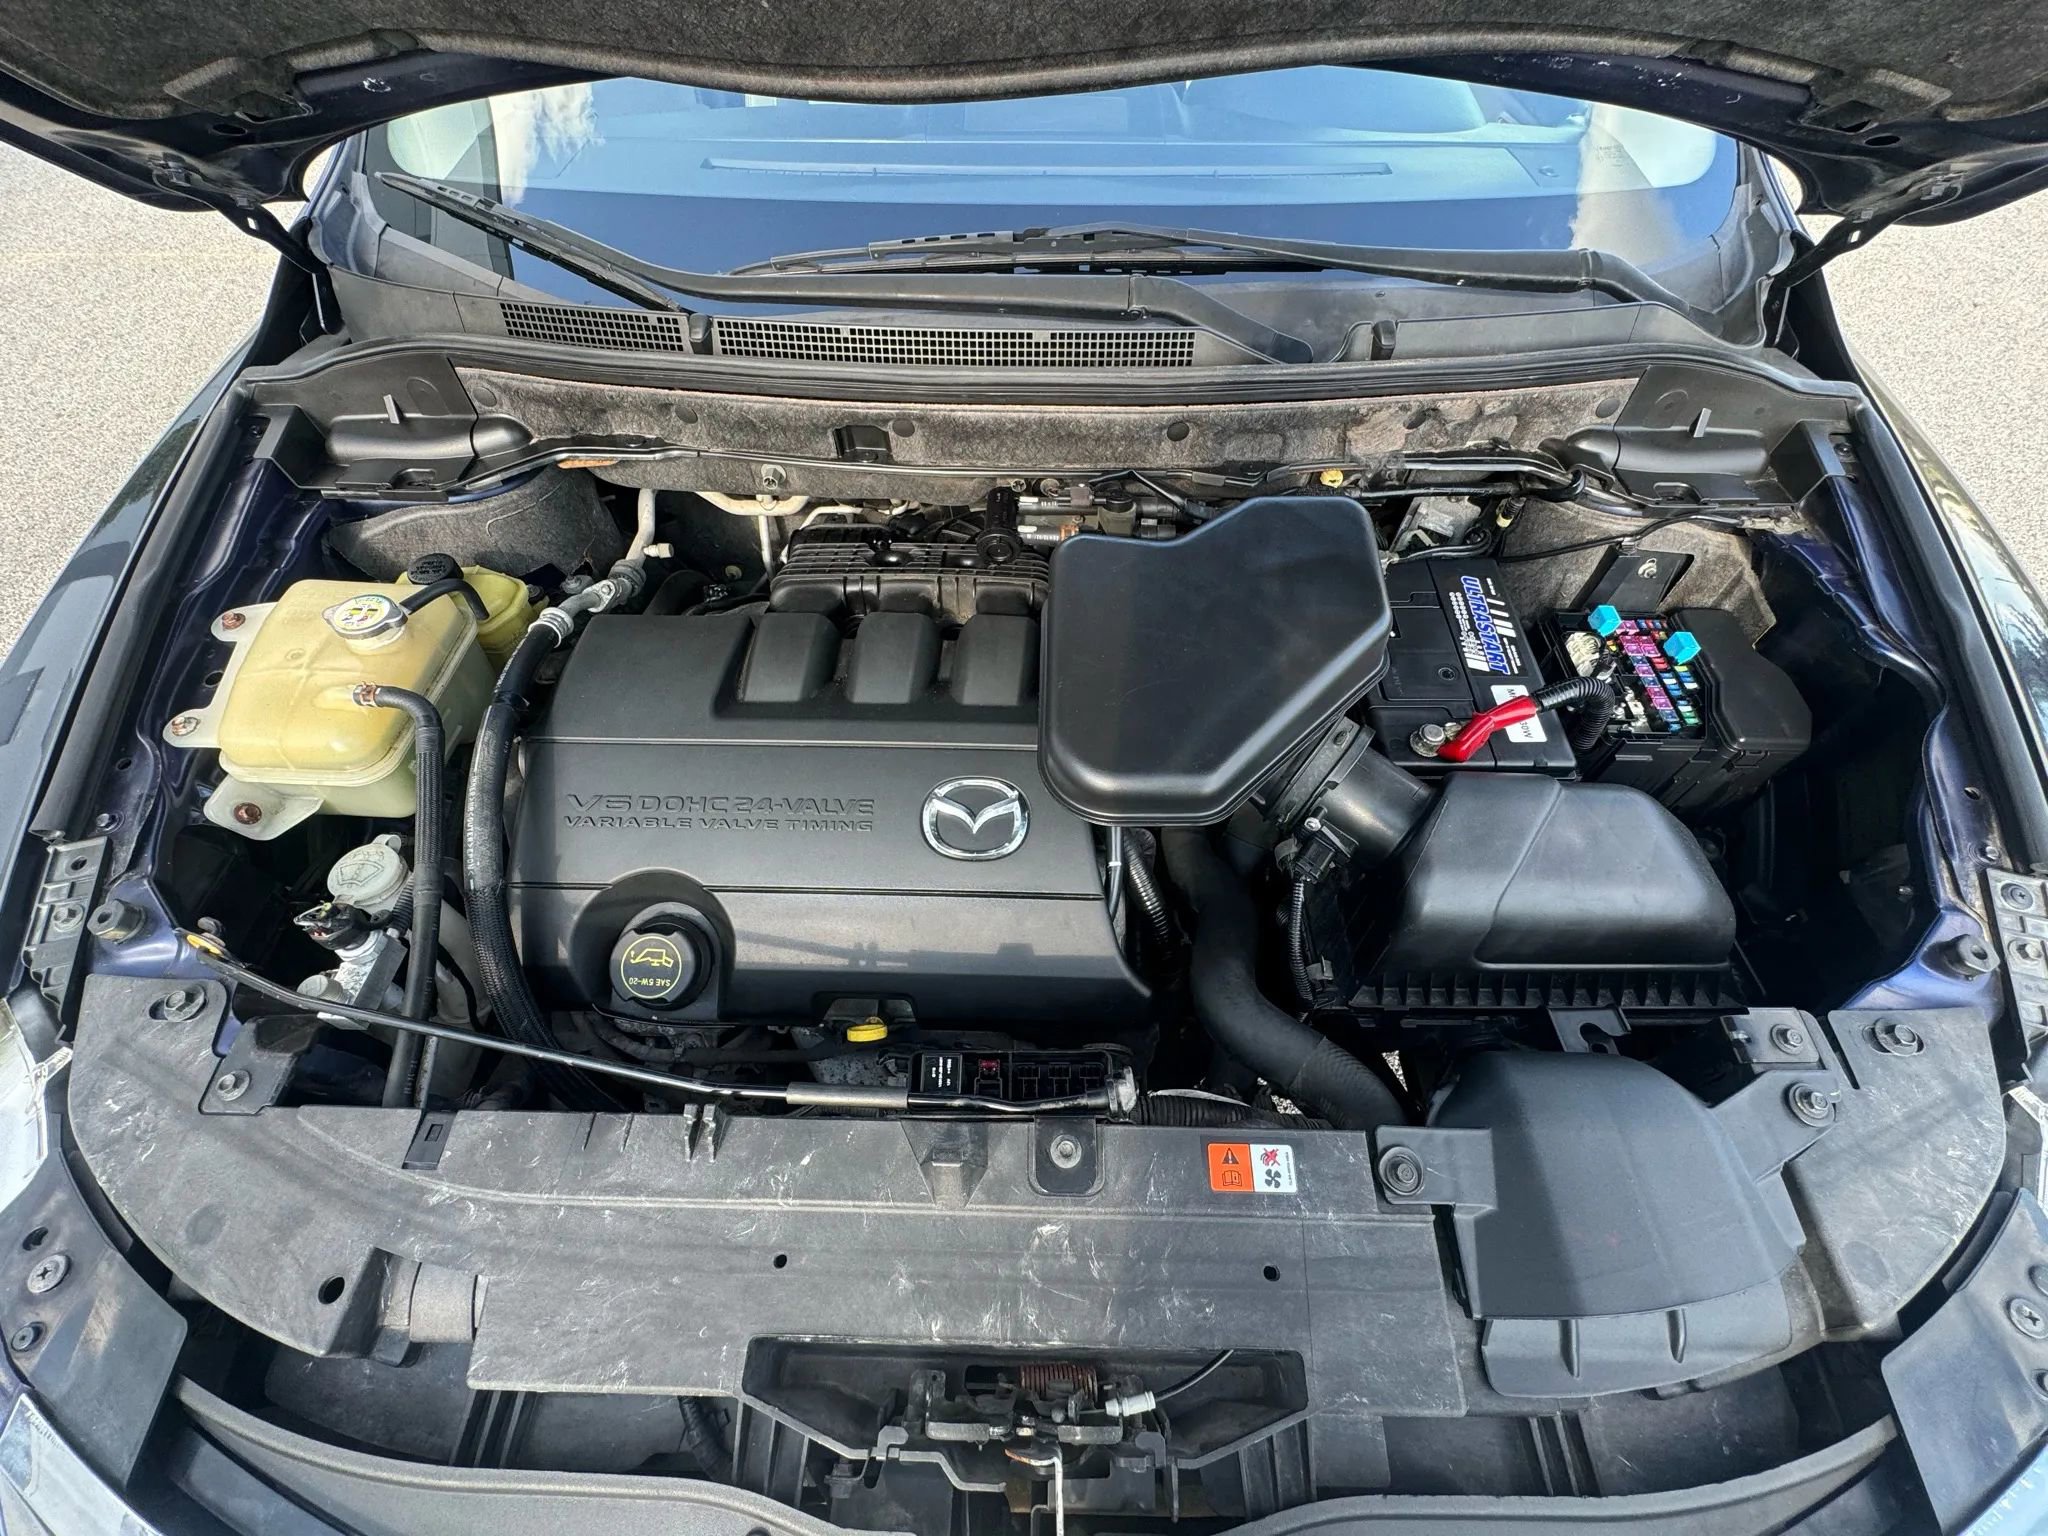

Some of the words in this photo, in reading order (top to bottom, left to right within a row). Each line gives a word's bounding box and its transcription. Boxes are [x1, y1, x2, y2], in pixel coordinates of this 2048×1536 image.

[1460, 576, 1511, 675] ULTRASTART
[567, 793, 632, 812] V6
[637, 795, 728, 814] DOHC
[733, 796, 875, 816] 24-VALVE
[564, 815, 692, 829] VARIABLE
[698, 818, 779, 831] VALVE
[784, 819, 873, 832] TIMING
[628, 977, 655, 986] 5W-20
[655, 978, 671, 987] SAE
